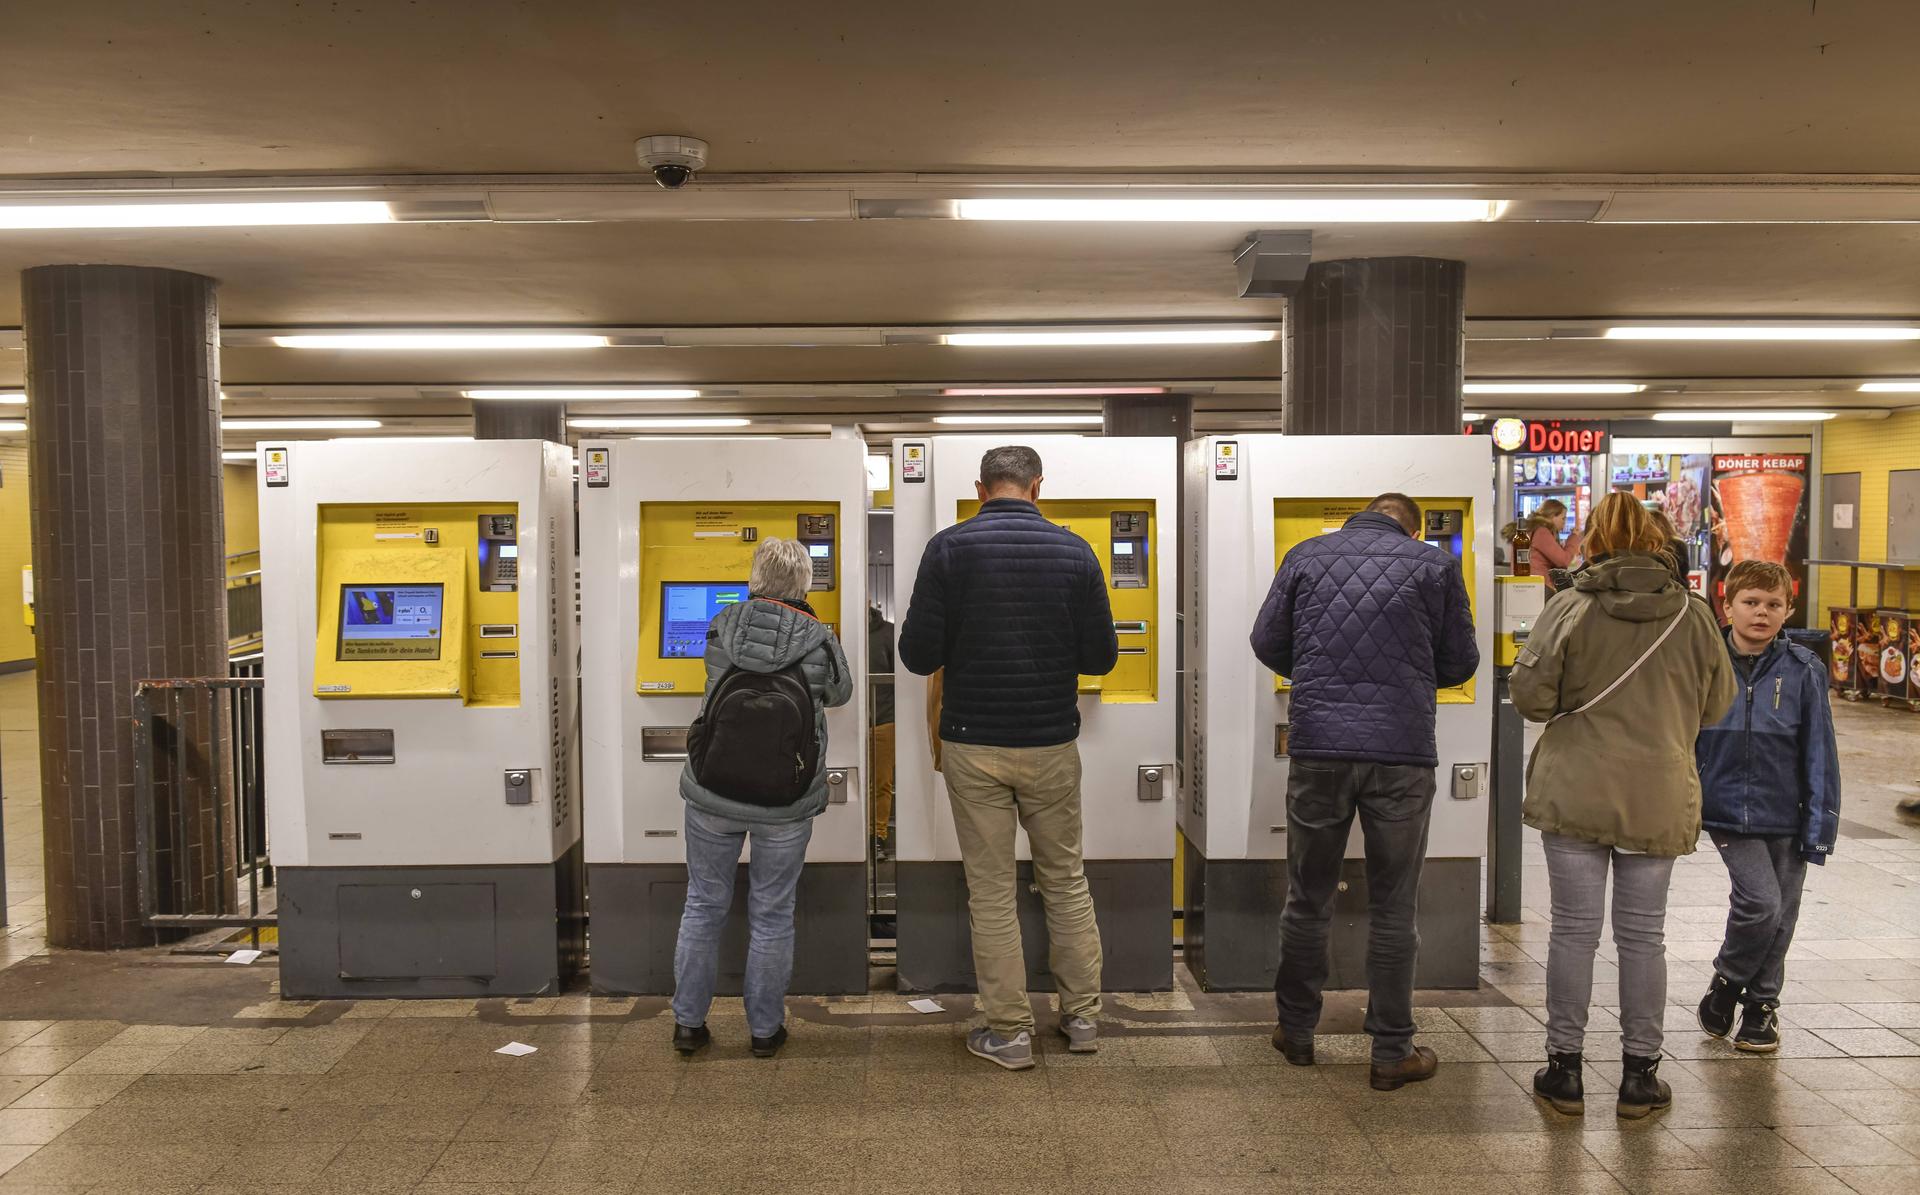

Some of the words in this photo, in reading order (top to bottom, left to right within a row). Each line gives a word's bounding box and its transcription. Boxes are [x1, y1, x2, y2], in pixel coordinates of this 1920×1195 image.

[1529, 422, 1605, 452] Döner
[1718, 458, 1760, 469] DÖNER
[1762, 458, 1803, 469] KEBAP
[552, 677, 561, 828] Fahrscheine
